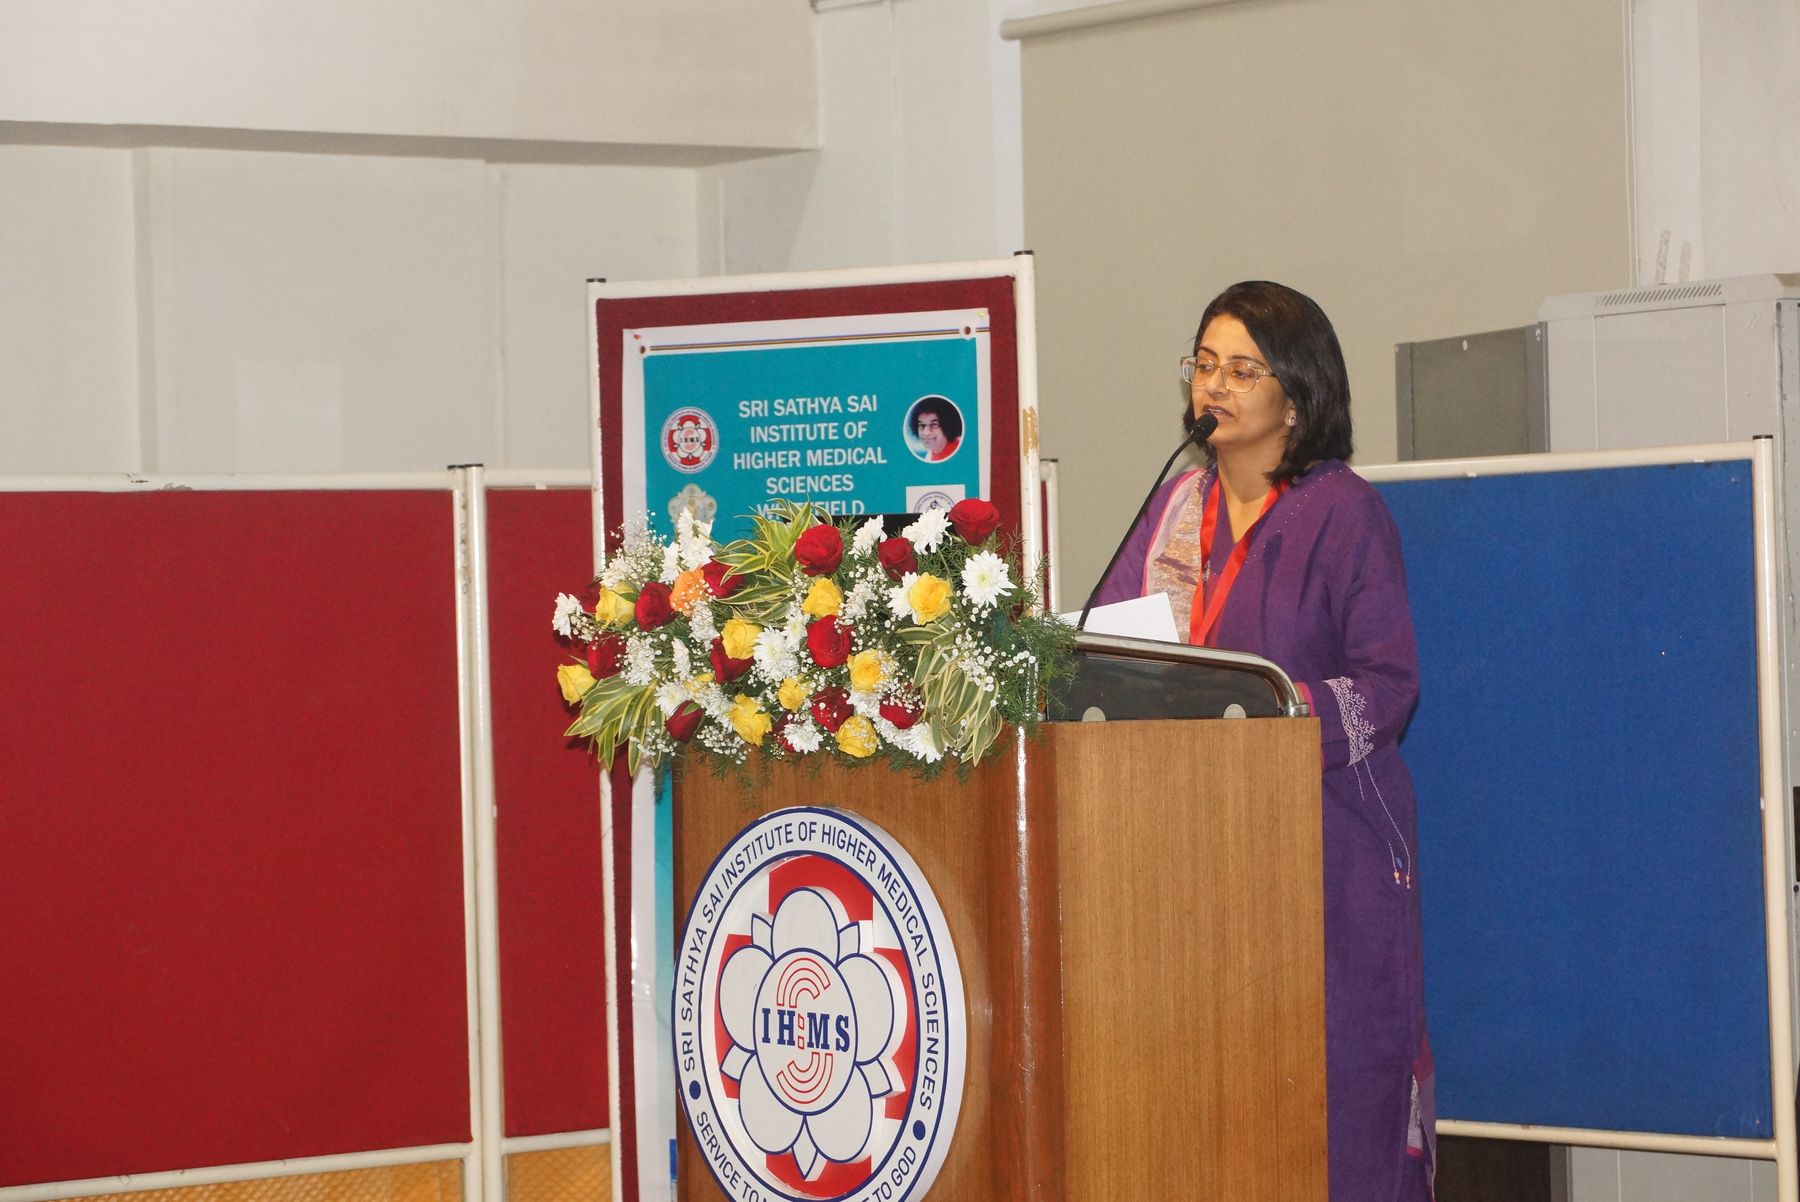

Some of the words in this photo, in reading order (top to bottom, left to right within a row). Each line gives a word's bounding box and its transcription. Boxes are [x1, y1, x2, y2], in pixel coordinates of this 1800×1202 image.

[738, 399, 769, 418] SRI
[773, 396, 843, 417] SATHYA
[847, 394, 878, 413] SAI
[750, 422, 839, 443] INSTITUTE
[843, 421, 868, 439] OF
[733, 450, 801, 470] HIGHER
[806, 446, 888, 467] MEDICAL
[766, 474, 855, 495] SCIENCES
[798, 821, 817, 842] OF
[821, 823, 877, 872] HIGHER
[721, 823, 794, 890] INSTITUTE
[702, 883, 724, 924] SAI
[877, 863, 928, 967] MEDICAL
[681, 927, 707, 1022] SATHYA
[681, 1031, 695, 1073] SRI
[919, 972, 939, 1111] SCIENCES
[696, 1111, 742, 1190] SERVICE
[743, 1181, 760, 1202] TO
[872, 1181, 893, 1201] TO
[890, 1146, 916, 1187] GOD
